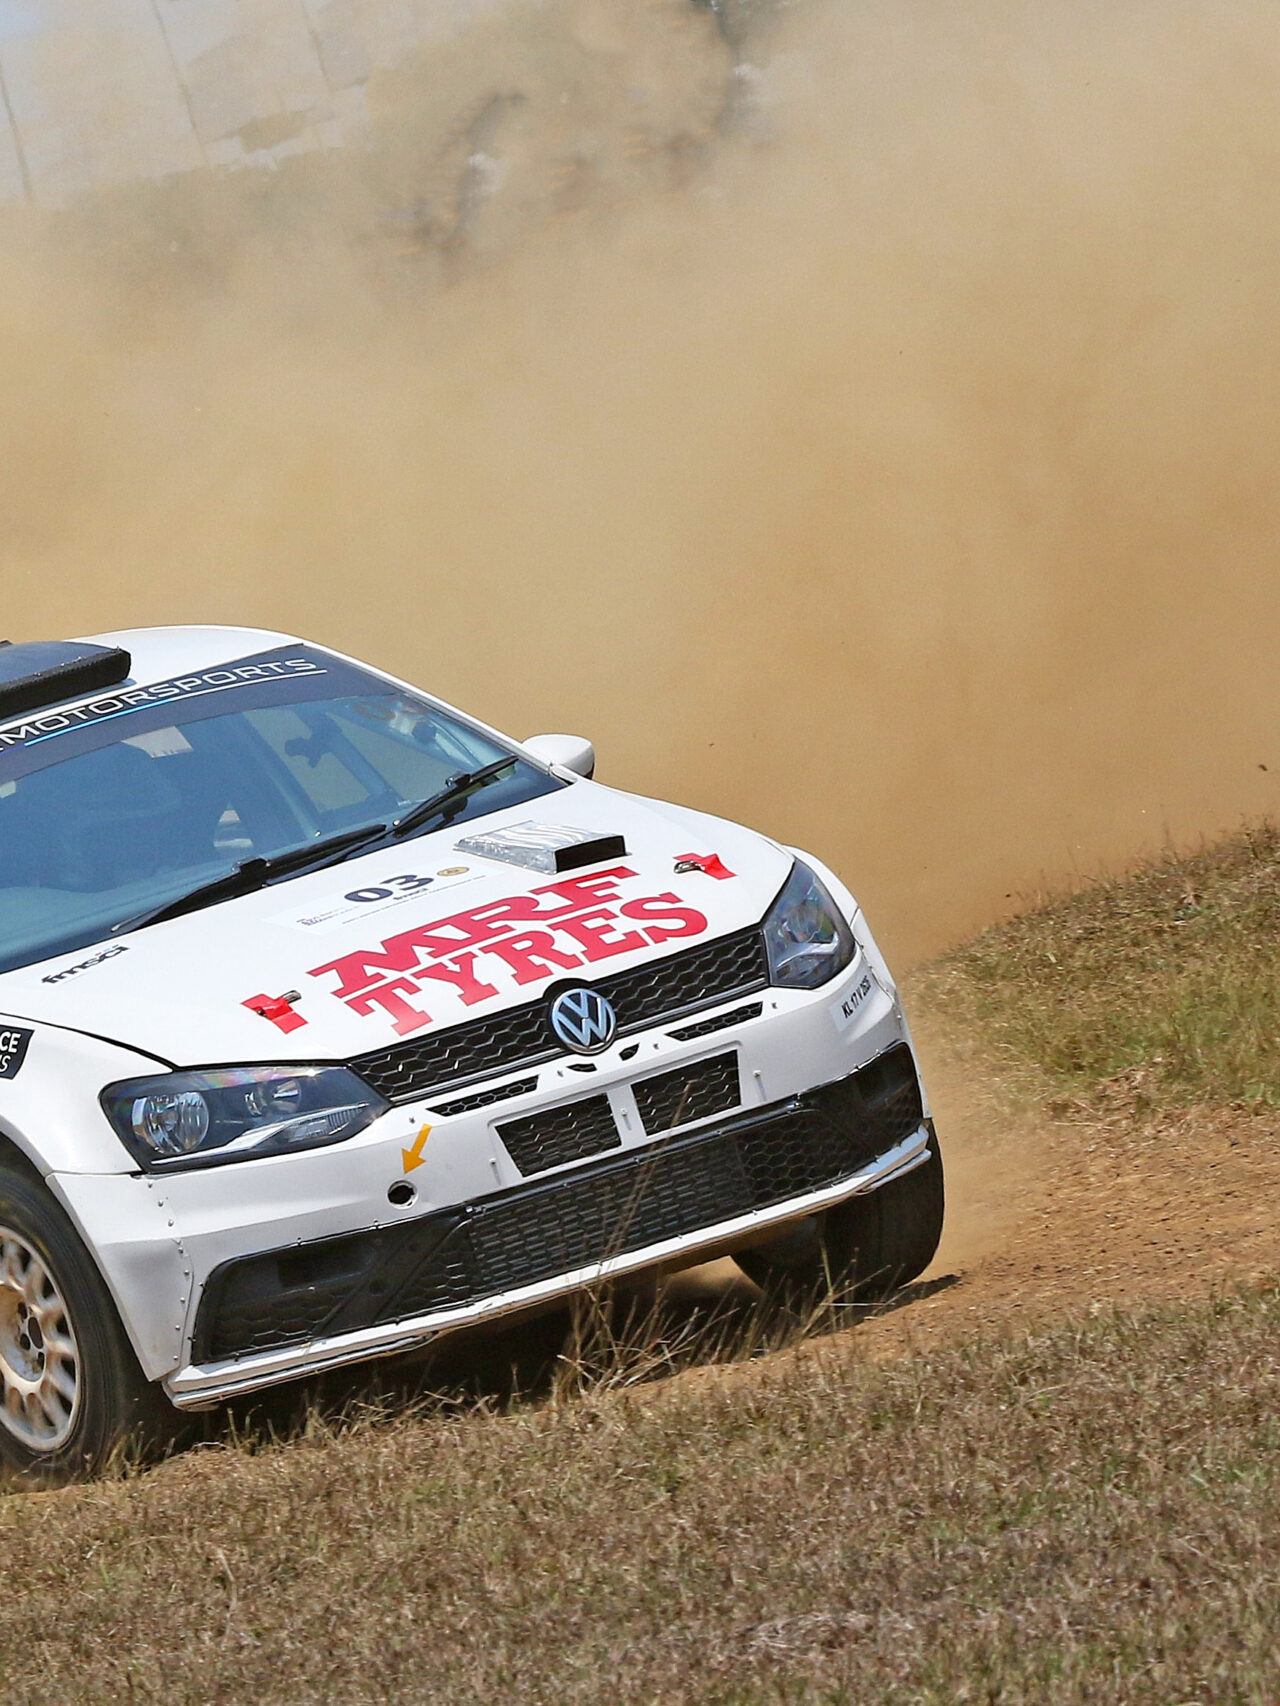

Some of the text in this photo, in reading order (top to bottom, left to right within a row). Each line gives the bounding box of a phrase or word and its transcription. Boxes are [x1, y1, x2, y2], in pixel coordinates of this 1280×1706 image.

[0, 658, 318, 747] MOTORSPORTS
[306, 865, 640, 999] MRF
[344, 874, 434, 903] 03
[41, 944, 131, 984] fmsci
[344, 891, 708, 1038] TYRES
